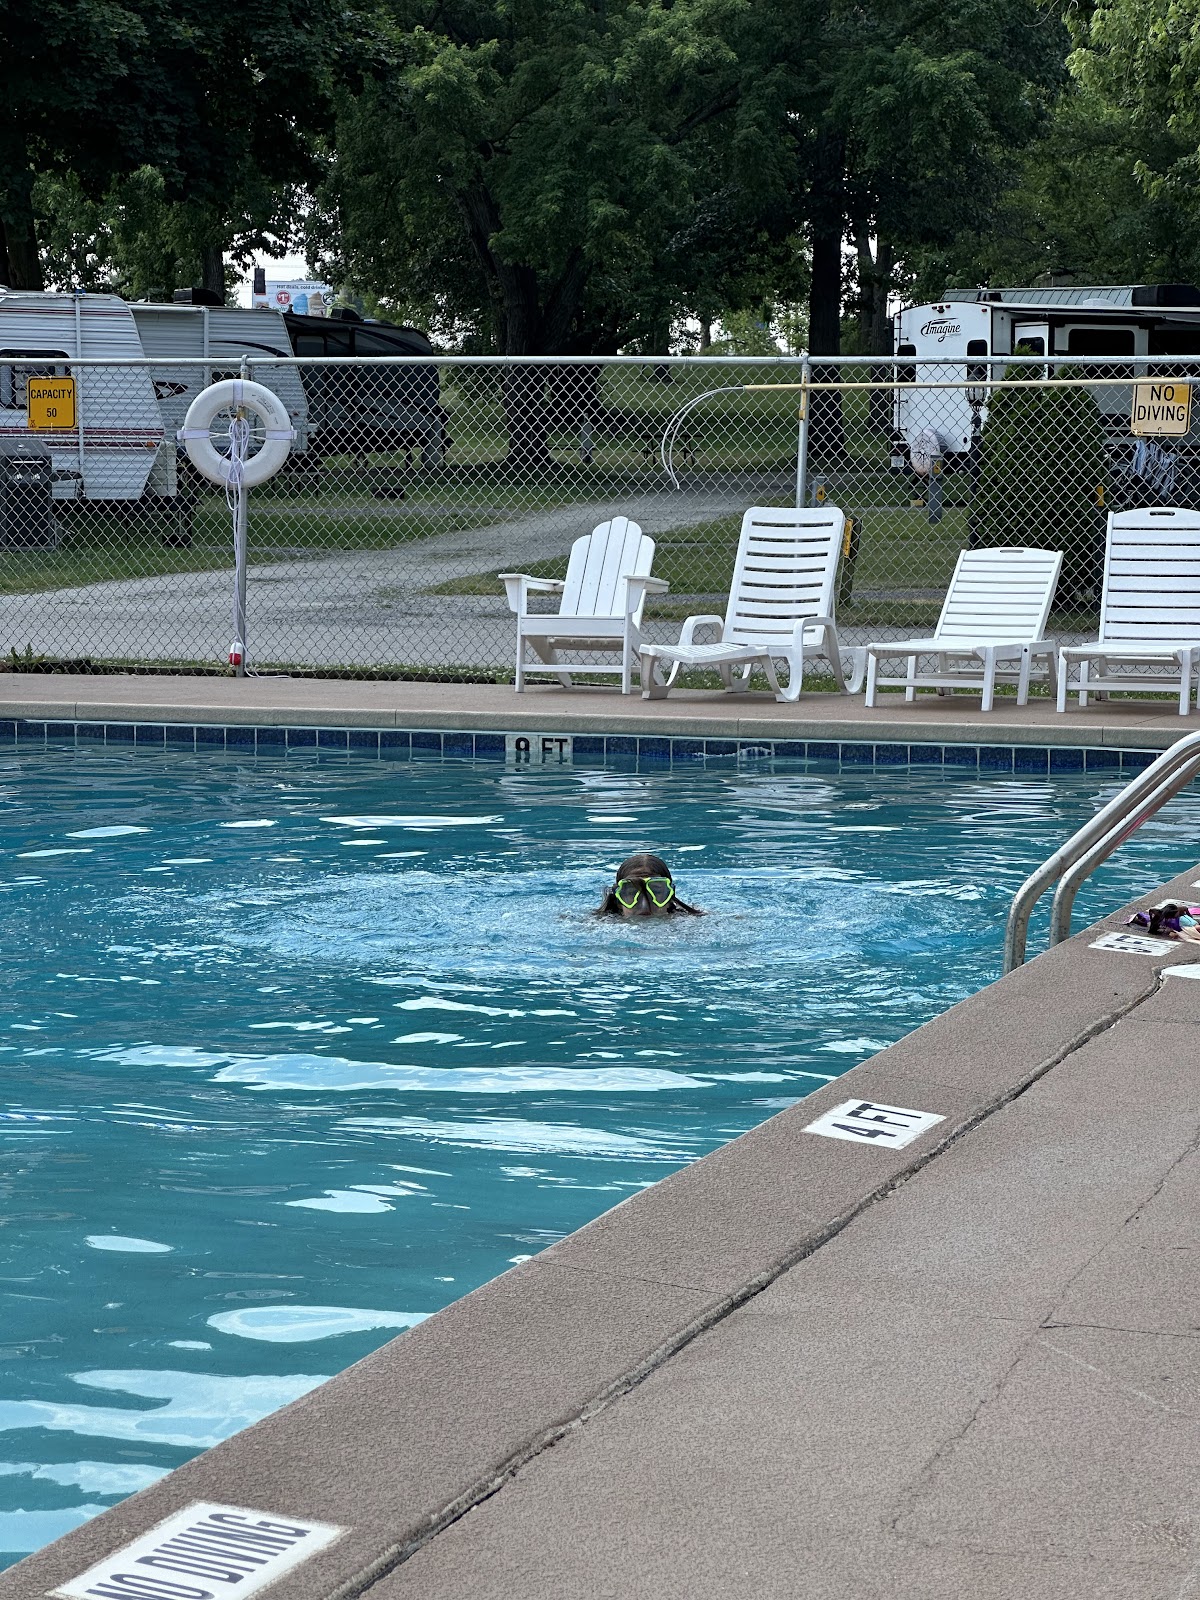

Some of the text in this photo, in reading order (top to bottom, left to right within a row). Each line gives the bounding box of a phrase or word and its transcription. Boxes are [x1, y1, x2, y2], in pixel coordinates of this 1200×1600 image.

[921, 319, 961, 342] Imagine
[30, 389, 72, 399] CAPACITY
[1150, 385, 1175, 401] NO
[46, 407, 57, 418] 50
[1137, 405, 1186, 421] DIVING
[541, 738, 568, 752] FT
[831, 1102, 922, 1139] 4 FT
[85, 1512, 312, 1600] NO DIVING
